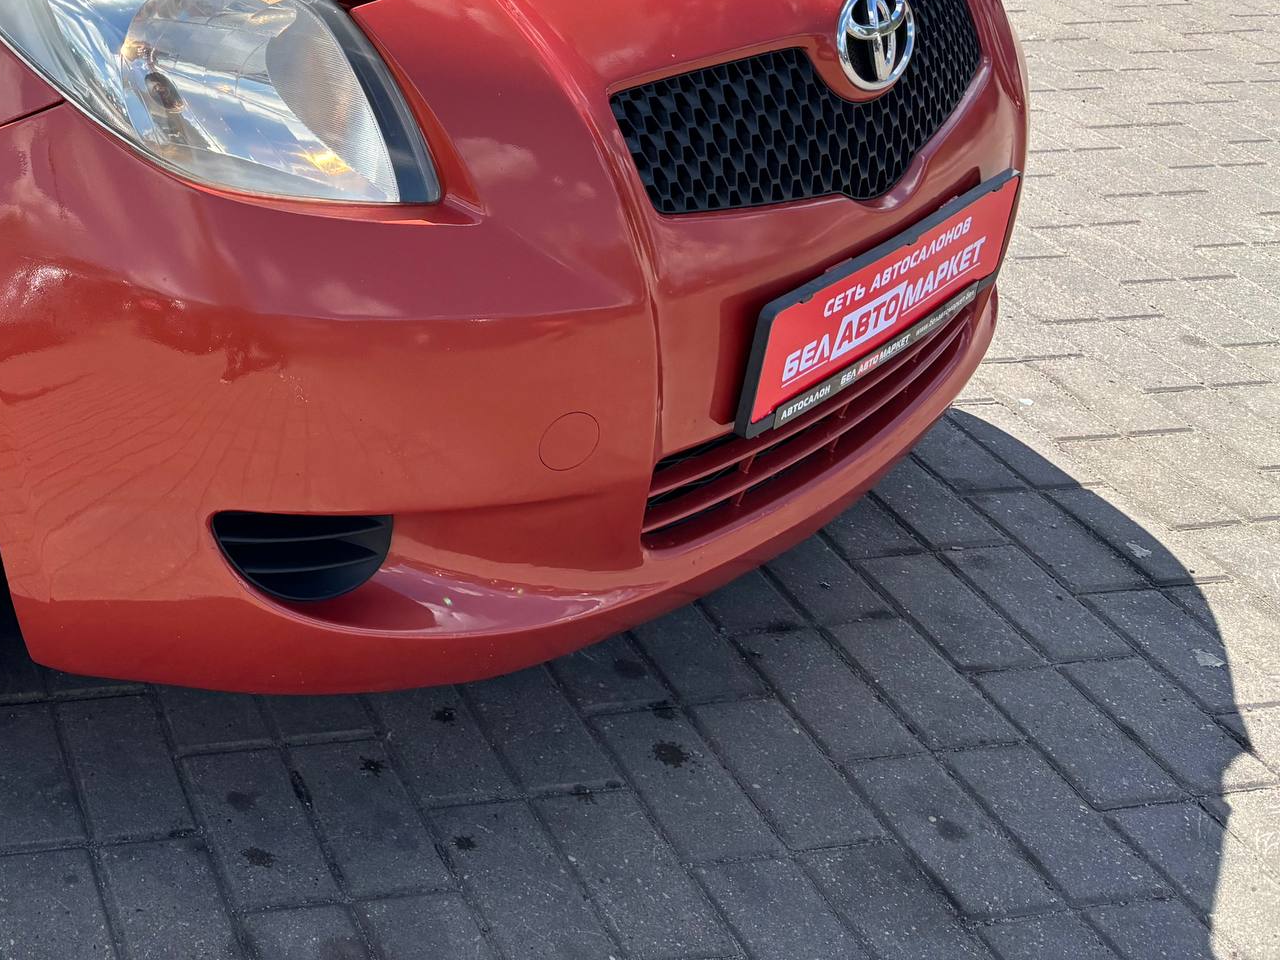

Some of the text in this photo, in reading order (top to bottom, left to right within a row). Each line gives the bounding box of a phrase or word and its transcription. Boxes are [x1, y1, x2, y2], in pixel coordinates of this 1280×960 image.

[823, 216, 972, 318] СЕТЬ АВТОСАЛОНОВ
[781, 384, 831, 420] АВТОСАЛОН
